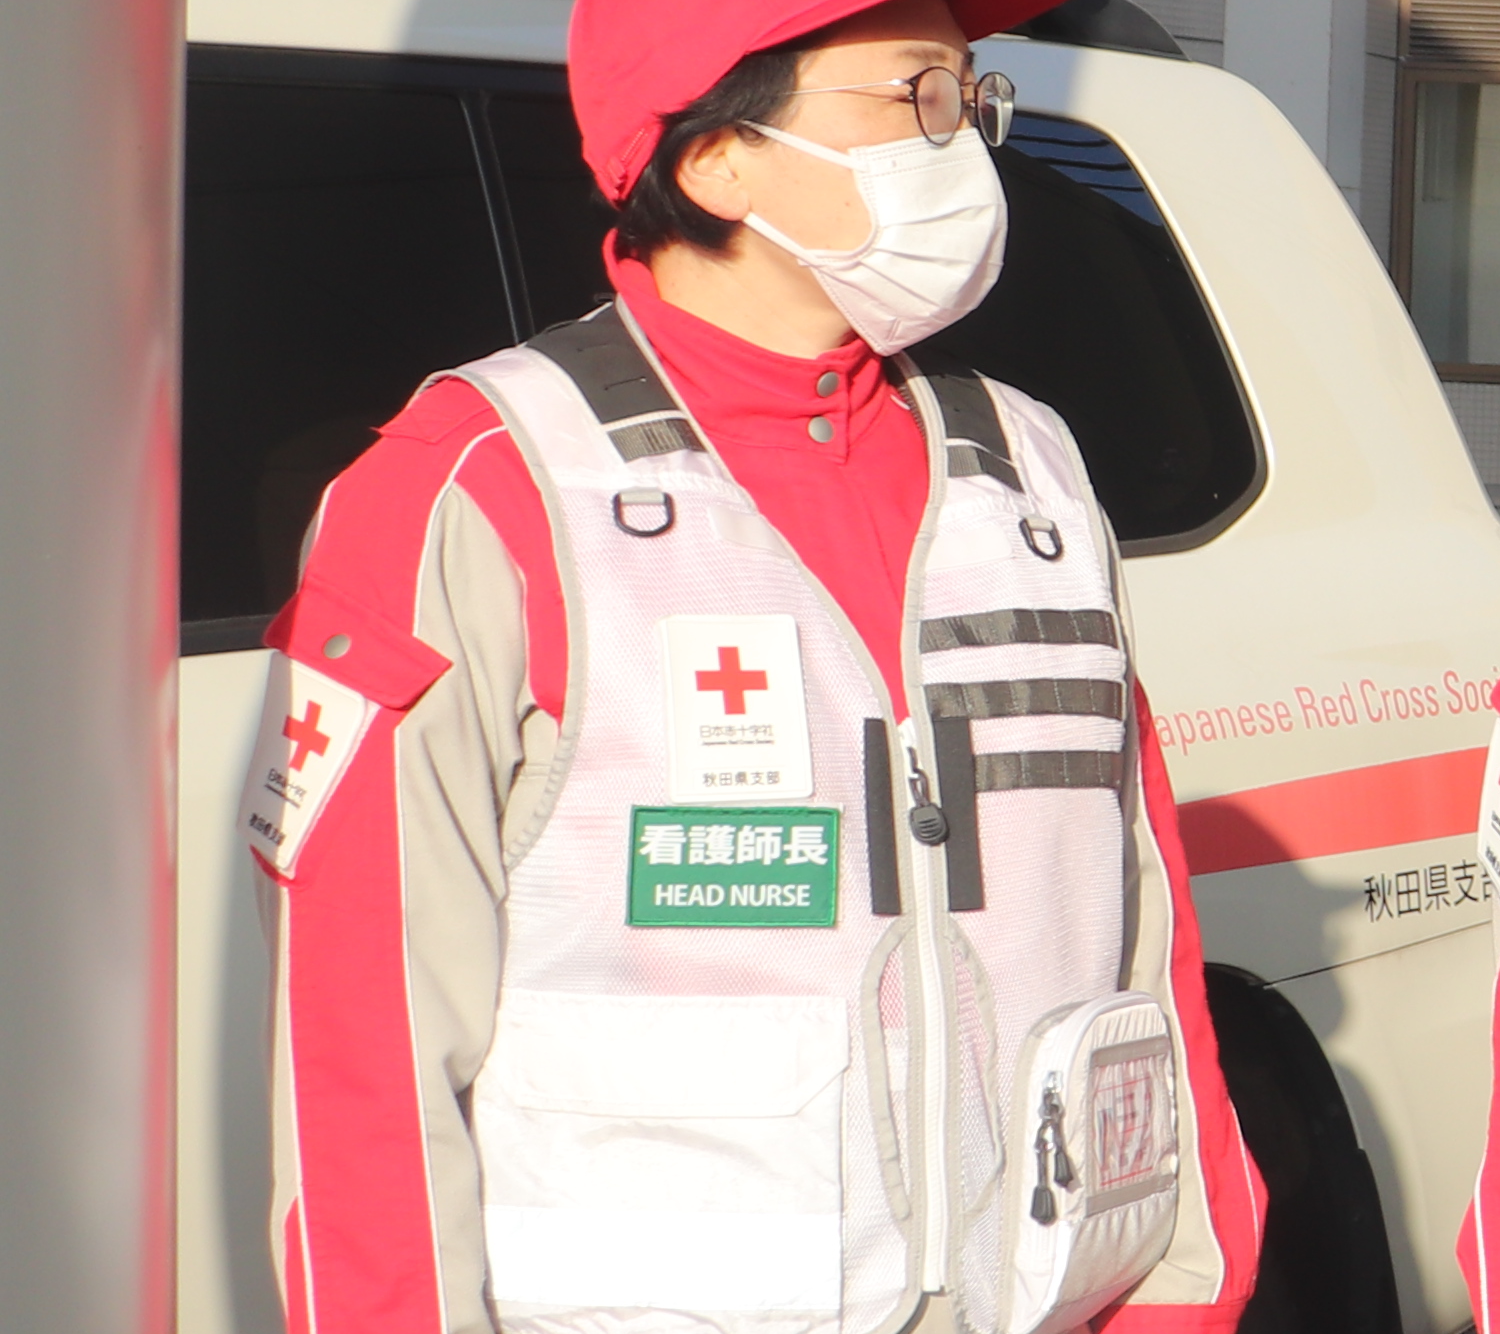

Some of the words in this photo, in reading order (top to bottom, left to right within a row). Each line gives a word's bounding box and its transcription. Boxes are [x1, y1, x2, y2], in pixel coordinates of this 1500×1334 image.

[1154, 701, 1294, 756] apanese
[1294, 681, 1359, 729] Red
[1359, 678, 1440, 723] Cross
[639, 824, 829, 866] 看護師長
[654, 883, 725, 906] HEAD
[730, 884, 811, 907] NURSE
